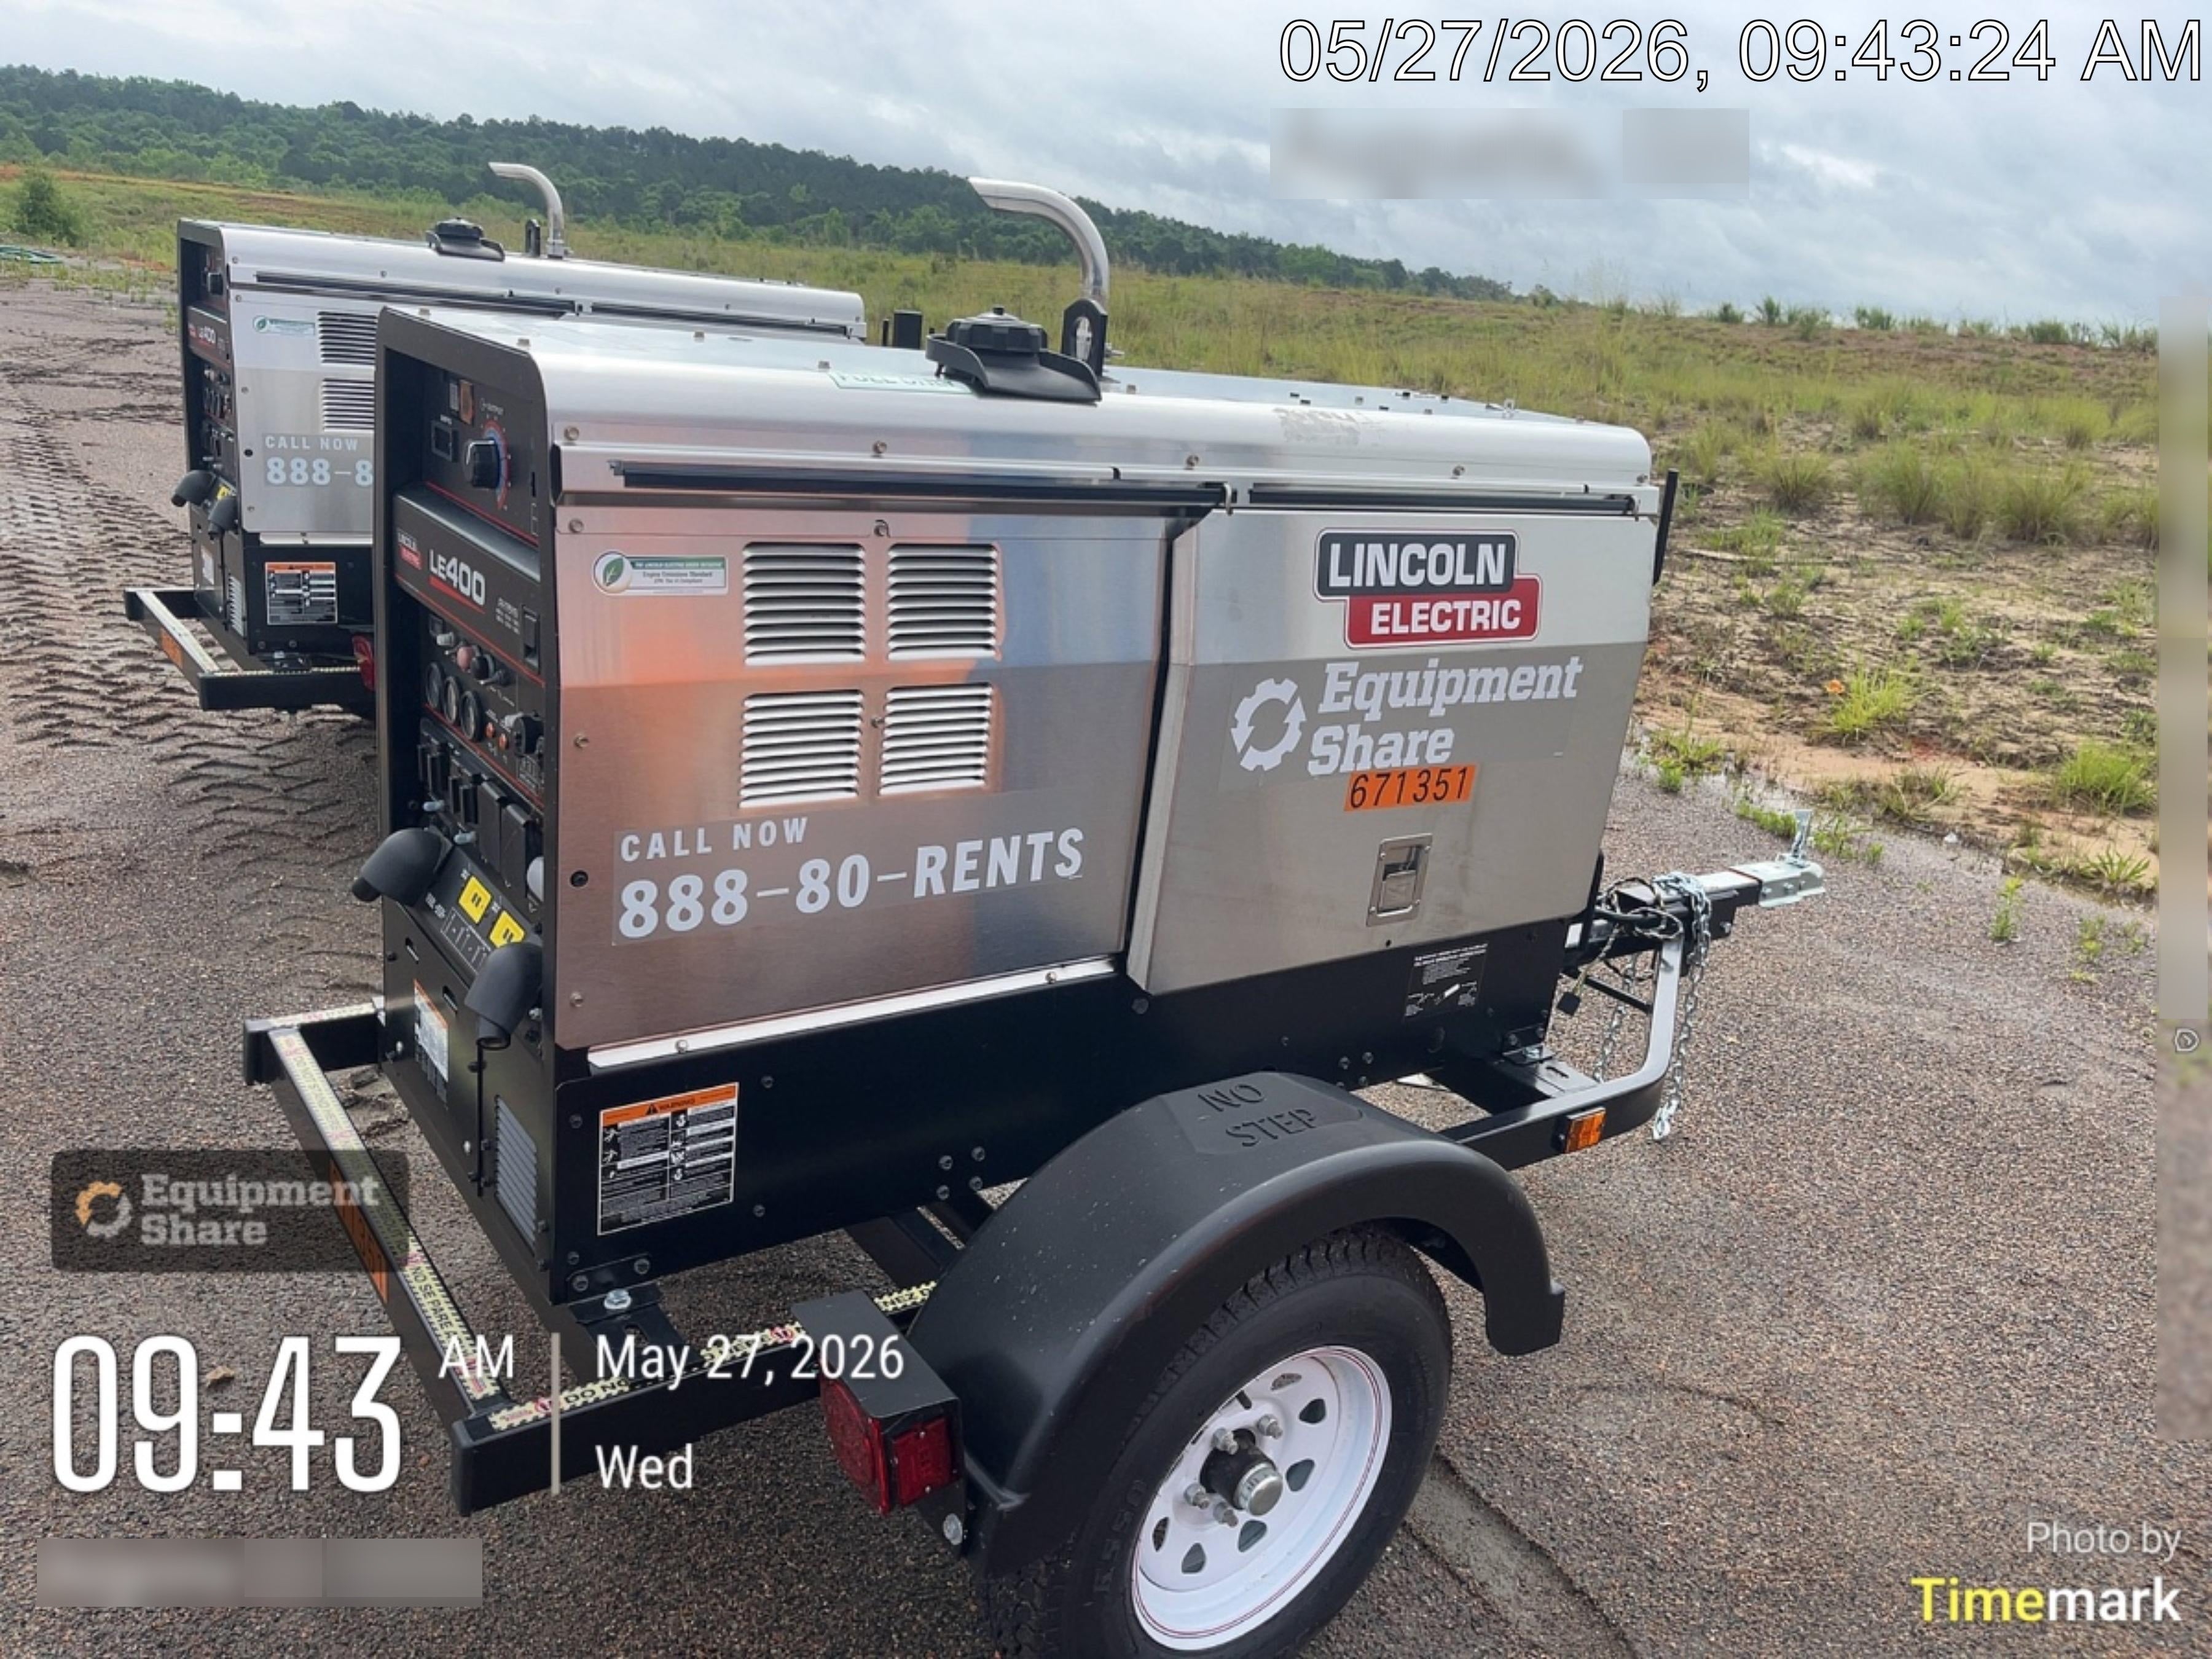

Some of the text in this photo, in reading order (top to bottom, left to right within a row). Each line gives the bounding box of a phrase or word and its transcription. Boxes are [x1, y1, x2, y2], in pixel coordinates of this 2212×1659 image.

[265, 435, 358, 451] CALL NOW
[429, 548, 486, 606] LE400
[1327, 543, 1507, 588] LINCOLN
[1370, 600, 1522, 635] ELECTRIC
[1318, 656, 1583, 722] Equipment
[1307, 724, 1455, 777] Share
[1351, 766, 1469, 809] 671351
[620, 817, 809, 862] CALL NOW
[1198, 1084, 1265, 1112] NO
[1225, 1108, 1317, 1147] STEP
[411, 1266, 454, 1329] NO SE PARE
[563, 1379, 630, 1403] DO NO
